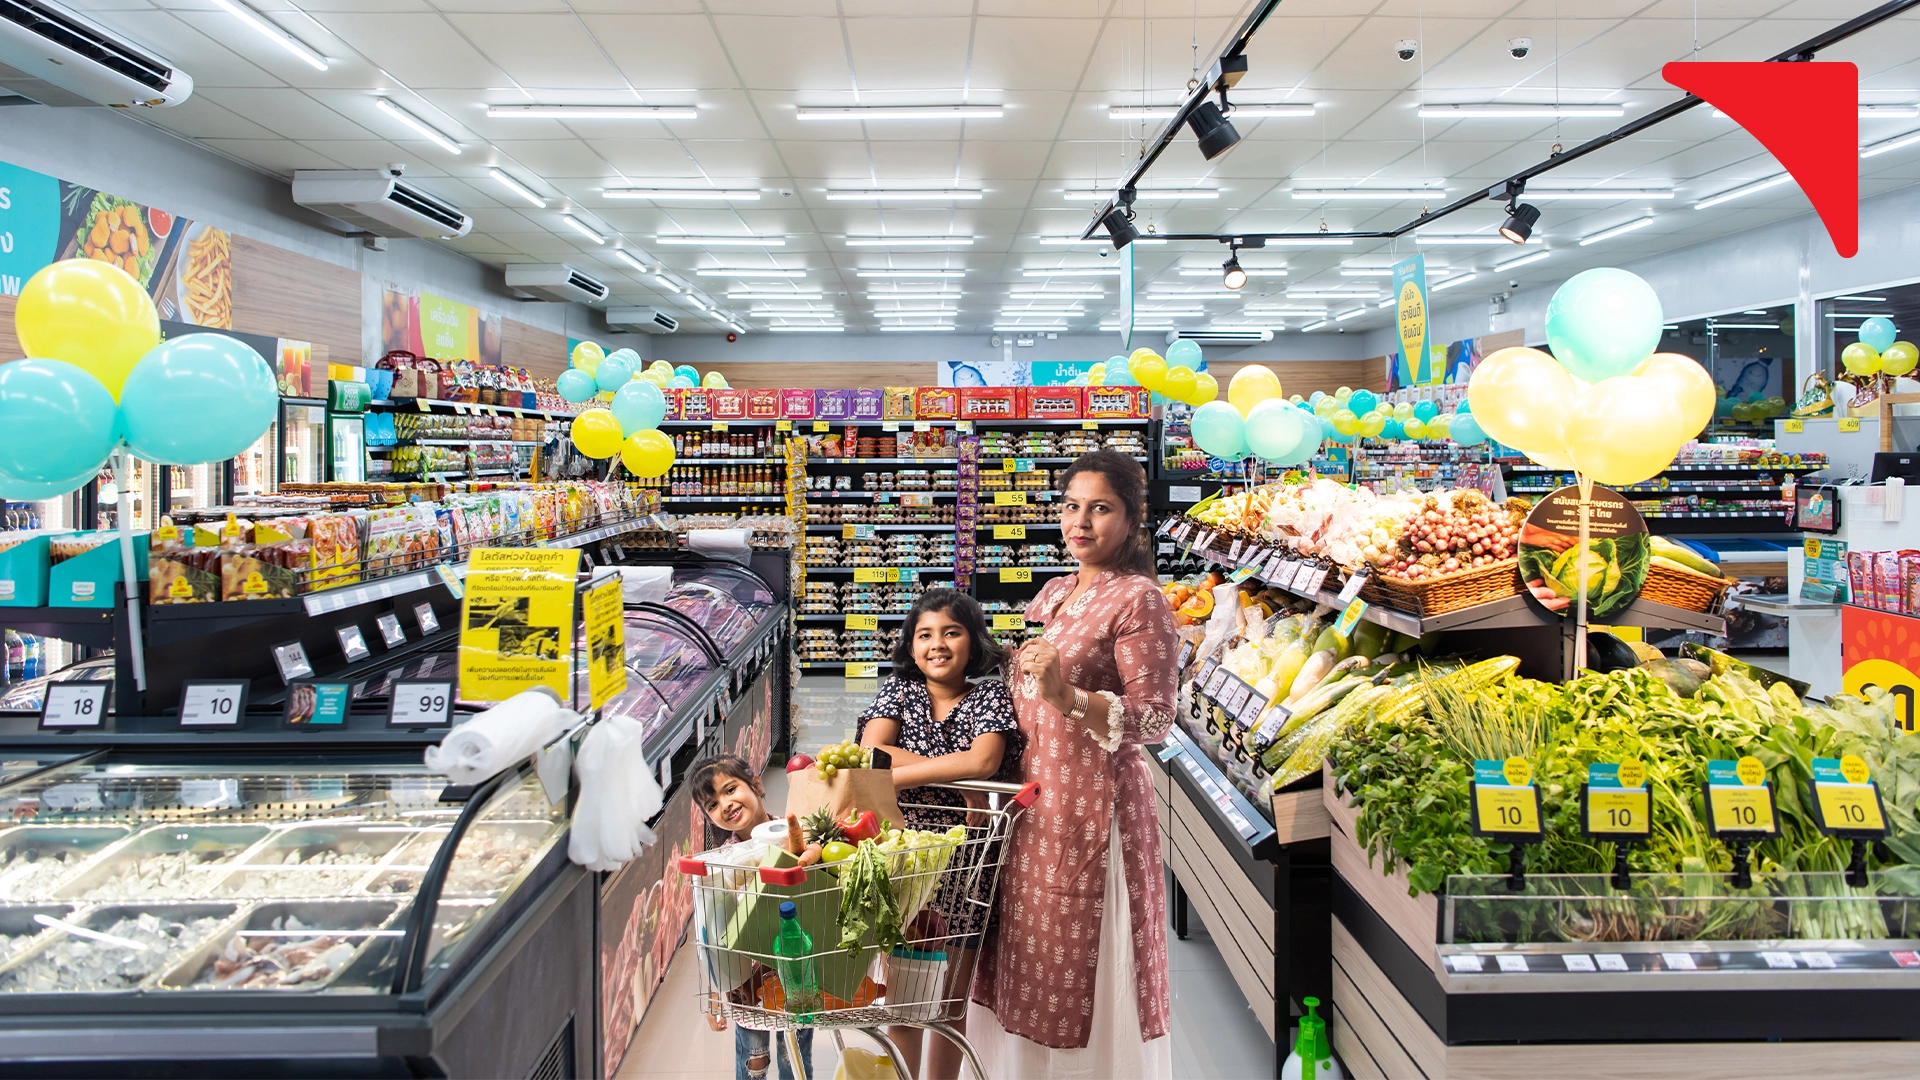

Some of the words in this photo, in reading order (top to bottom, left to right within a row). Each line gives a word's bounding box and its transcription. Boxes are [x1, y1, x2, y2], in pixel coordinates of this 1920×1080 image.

[1011, 494, 1024, 502] 55
[1577, 508, 1595, 517] SE
[1010, 528, 1023, 536] 45
[1016, 571, 1029, 579] 99
[1010, 617, 1022, 626] 99
[288, 651, 302, 664] 144
[74, 698, 94, 715] 18
[211, 697, 233, 715] 10
[419, 695, 445, 713] 99
[1497, 806, 1522, 825] 10
[1608, 808, 1632, 827] 10
[1732, 806, 1756, 825] 10
[1839, 804, 1865, 823] 10
